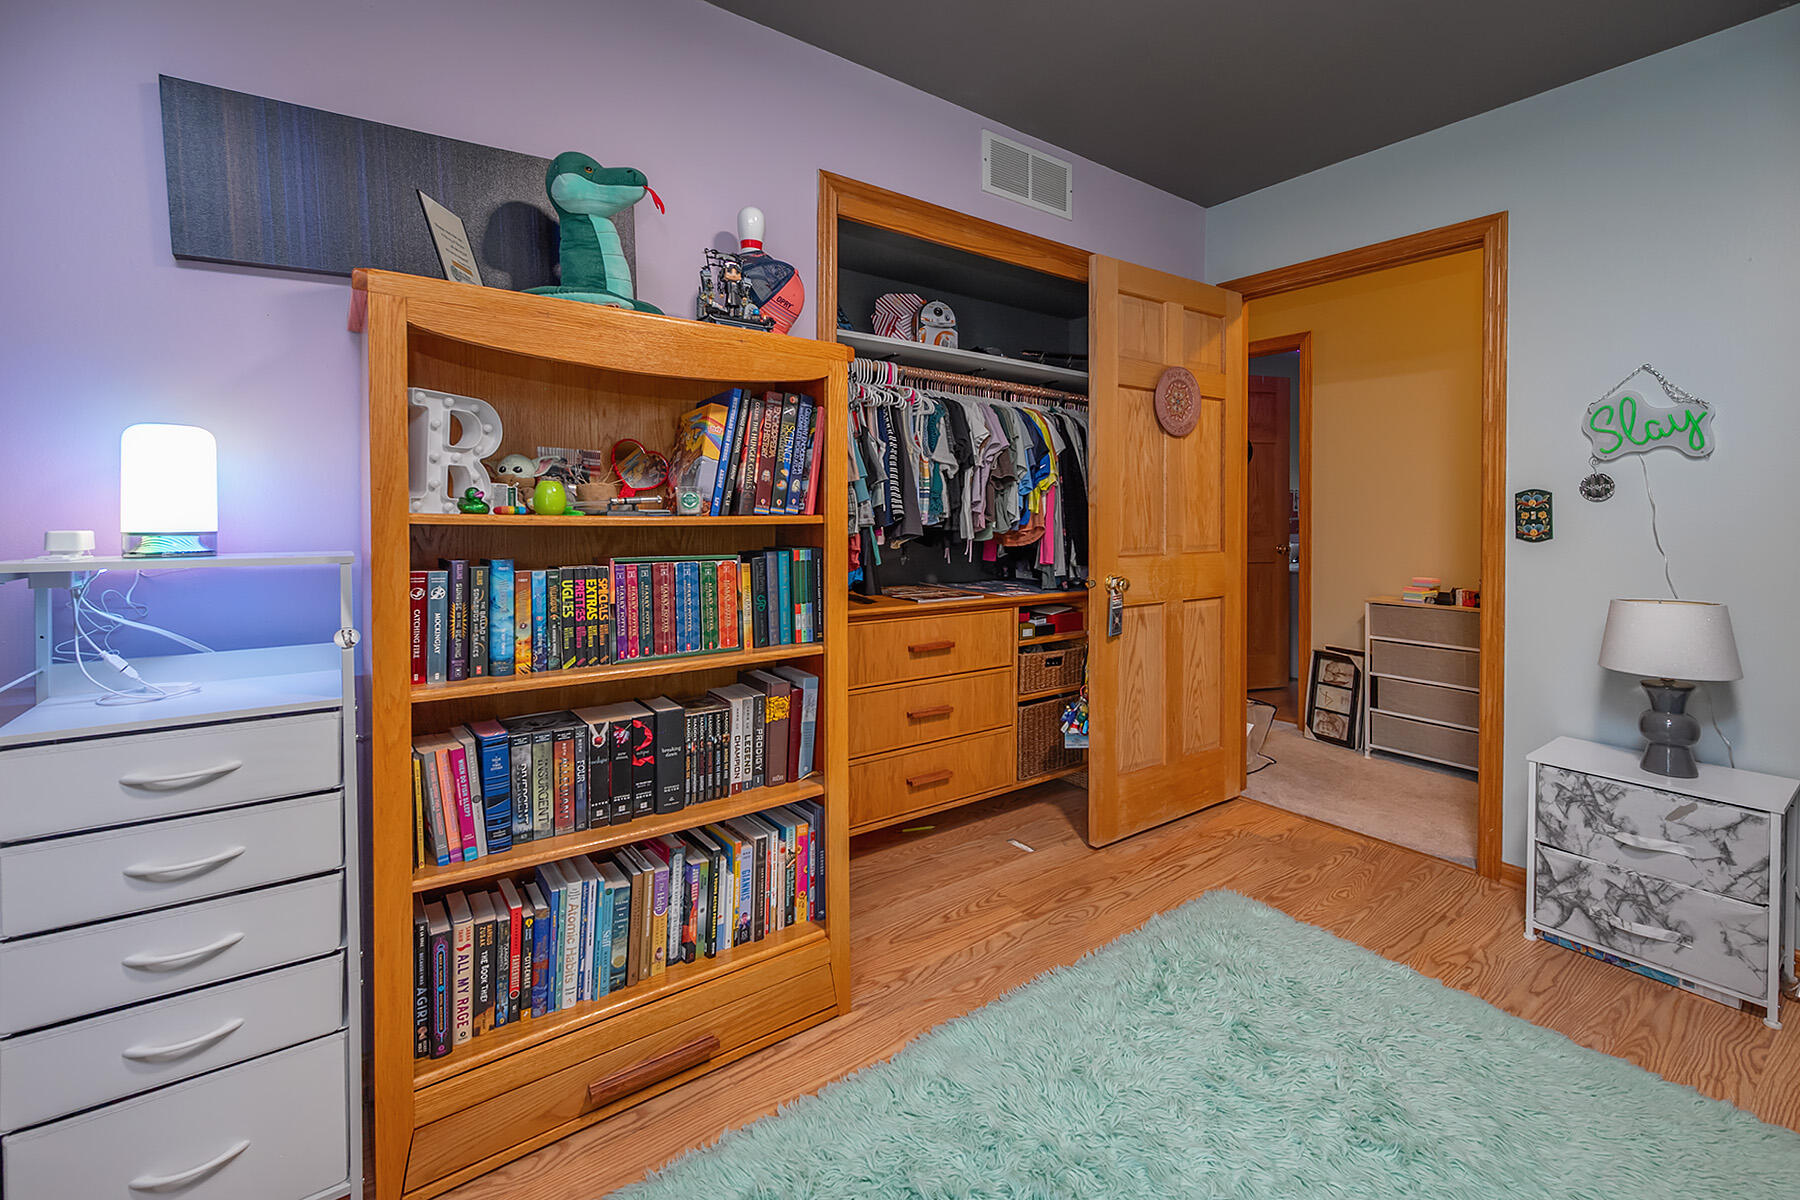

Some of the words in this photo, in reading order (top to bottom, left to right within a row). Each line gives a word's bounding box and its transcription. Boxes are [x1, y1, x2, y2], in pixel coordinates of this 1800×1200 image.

[775, 296, 794, 310] OPRY
[768, 405, 781, 458] ENCYCLOPEDIA
[1590, 396, 1707, 454] Slay
[734, 437, 742, 454] SCHOOL
[748, 432, 758, 462] HUNGER
[760, 429, 770, 458] HISTORY
[782, 424, 795, 464] SCIENCE
[745, 463, 754, 489] GAMES
[561, 580, 574, 619] UGLIES
[575, 579, 586, 622] PRETTIES
[585, 578, 598, 621] EXTRAS
[597, 578, 609, 621] SPECIALS
[433, 612, 441, 654] MOCKINGJAY
[754, 728, 762, 770] PRODIGY
[457, 758, 465, 774] WHEN
[460, 775, 466, 783] DO
[577, 759, 585, 782] FOUR
[515, 763, 529, 825] DIVERGENT
[536, 759, 550, 824] INSURGENT
[558, 757, 570, 820] ALLEGIANT
[462, 797, 471, 817] SLEEP?
[690, 882, 698, 902] GREEN
[739, 868, 752, 901] GIANNIS
[655, 891, 665, 911] Help
[565, 903, 579, 944] Atomic
[601, 929, 610, 946] Stiff
[457, 954, 469, 974] ALL
[480, 965, 489, 983] BOOK
[510, 954, 520, 988] FAHRENHEIT
[563, 945, 577, 983] Habits
[416, 987, 427, 995] A
[457, 977, 469, 993] MY
[480, 984, 488, 1002] THIEF
[416, 996, 427, 1025] GIRL
[457, 997, 469, 1028] RAGE
